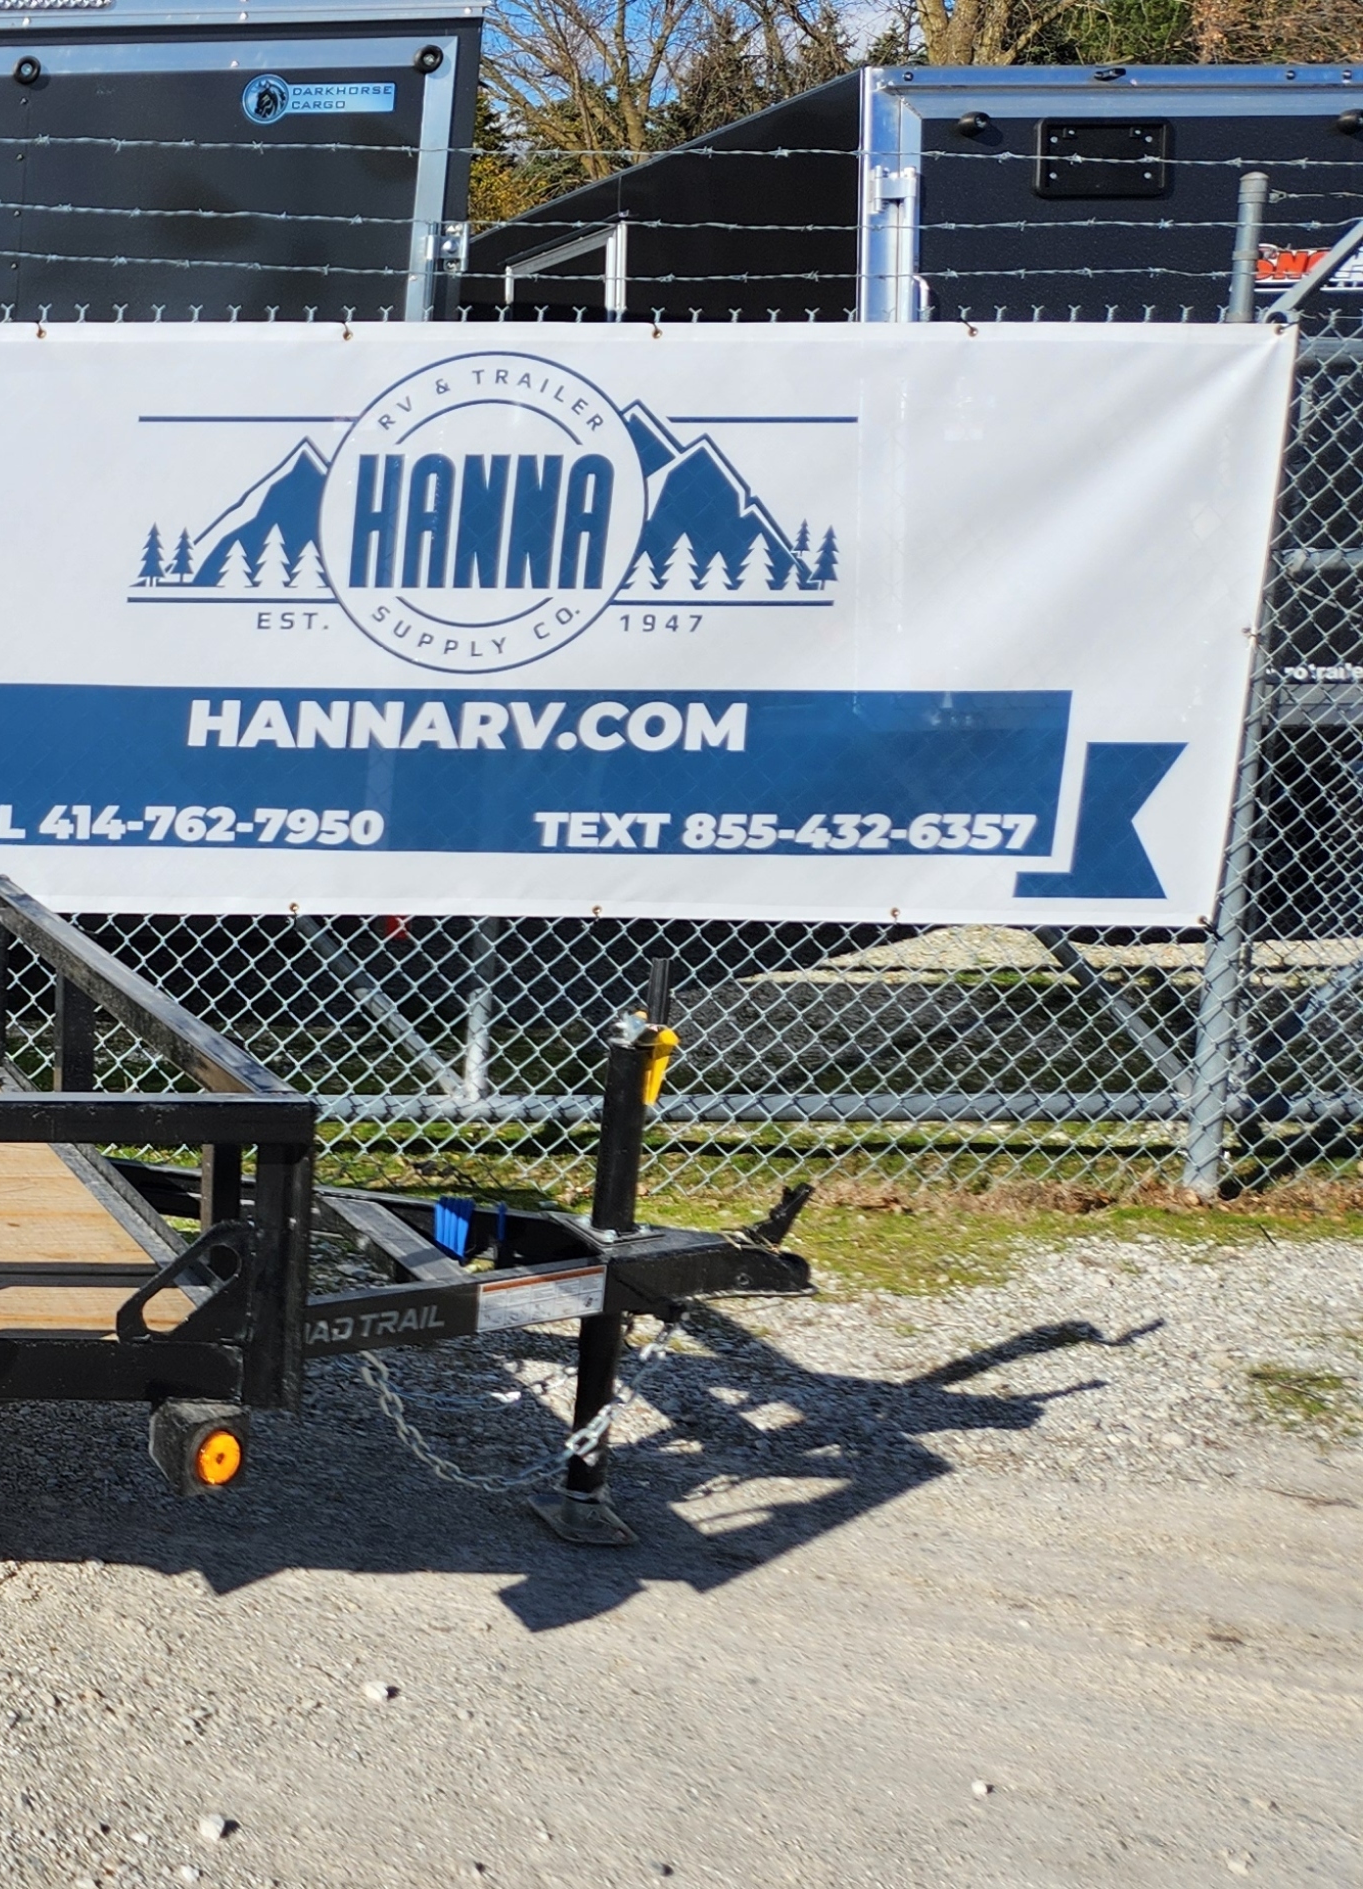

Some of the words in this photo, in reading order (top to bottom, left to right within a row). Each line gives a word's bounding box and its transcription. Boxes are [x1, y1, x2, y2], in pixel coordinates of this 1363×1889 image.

[291, 100, 346, 110] CARGO
[292, 85, 392, 96] DARKHORSE
[377, 396, 414, 431] RV
[434, 378, 451, 395] &
[471, 368, 605, 432] TRAILER
[348, 453, 615, 590] HANNA
[255, 612, 330, 631] EST.
[371, 605, 507, 657] SUPPLY
[532, 605, 581, 640] CO.
[618, 613, 705, 634] 1947
[187, 699, 748, 752] HANNARV.COM
[38, 804, 385, 846] 414-762-7950
[533, 811, 672, 848] TEXT
[681, 812, 1037, 850] 855-432-6357
[304, 1317, 355, 1345] AD
[360, 1304, 446, 1338] TRAIL
